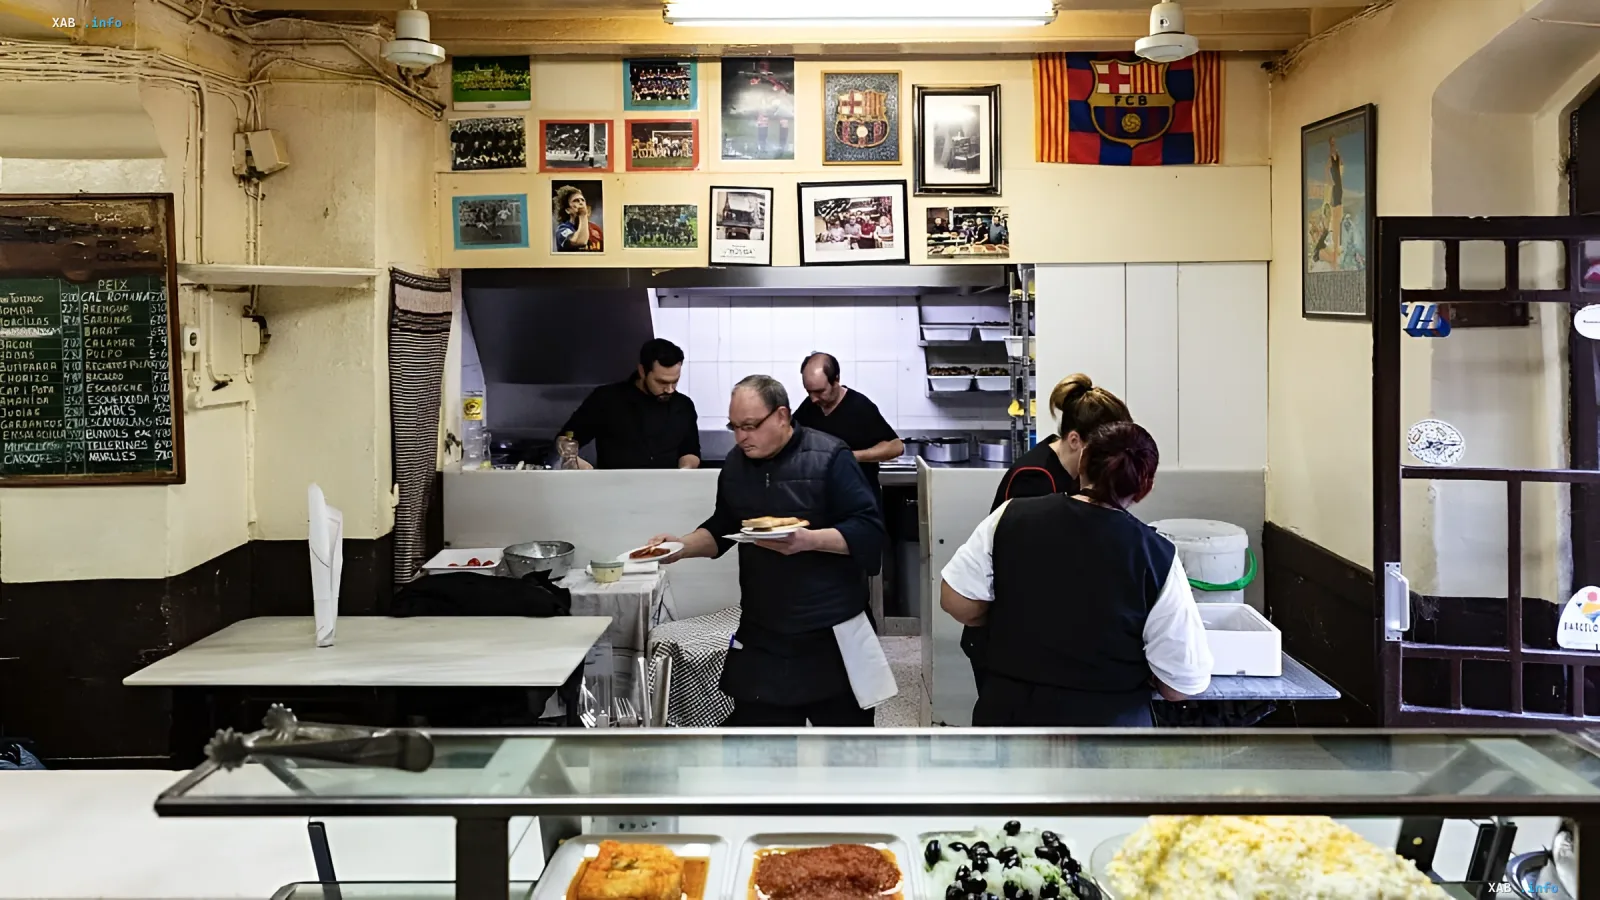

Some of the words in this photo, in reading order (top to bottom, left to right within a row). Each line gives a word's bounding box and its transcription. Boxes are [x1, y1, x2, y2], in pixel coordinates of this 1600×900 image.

[1114, 95, 1148, 106] FCB
[98, 279, 128, 291] PEIX
[85, 338, 135, 348] CALAMAR
[86, 349, 123, 359] PULPO
